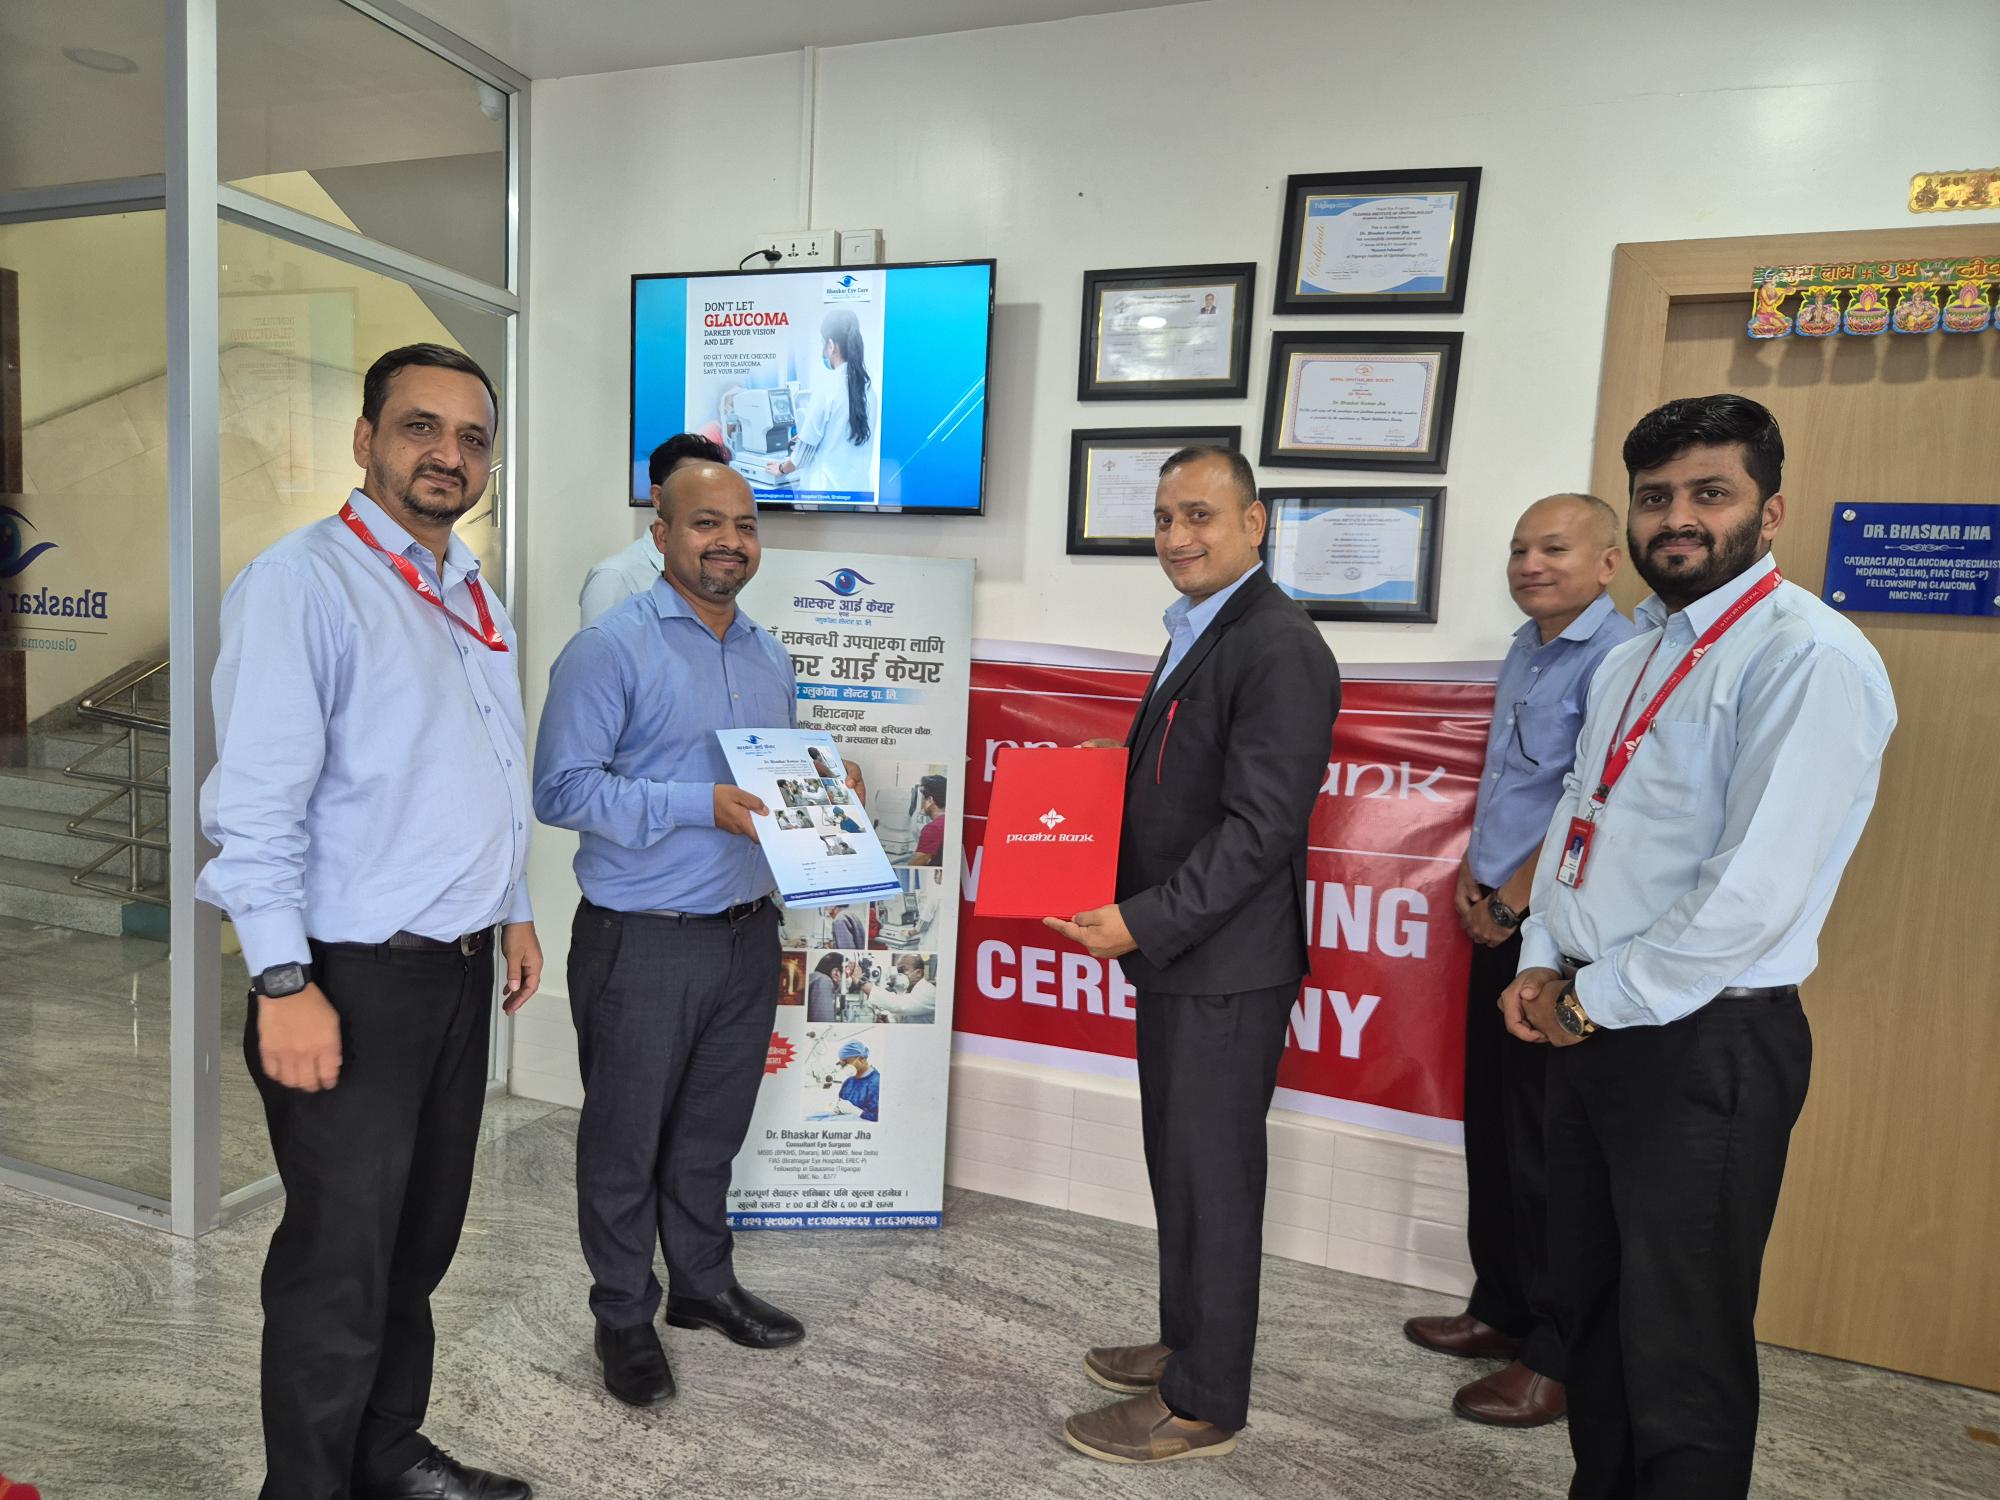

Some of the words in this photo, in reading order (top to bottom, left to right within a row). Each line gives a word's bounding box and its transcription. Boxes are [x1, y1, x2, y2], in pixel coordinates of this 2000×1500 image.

[704, 301, 734, 312] DON'T
[735, 300, 755, 311] LET
[704, 312, 789, 328] GLAUCOMA
[1863, 524, 1888, 539] DR.
[1889, 524, 1961, 540] BHASKAR
[1962, 525, 1992, 541] JHA
[1843, 556, 1886, 567] CATARACT
[1887, 557, 1905, 567] AND
[1906, 558, 1955, 569] GLAUCOMA
[1930, 569, 1950, 578] FIAS
[1865, 579, 1918, 589] FELLOWSHIP
[1918, 580, 1928, 589] IN
[1929, 580, 1976, 590] GLAUCOMA
[1888, 591, 1909, 600] NMC
[793, 596, 836, 610] भास्कर
[839, 597, 864, 613] आई
[866, 599, 895, 614] केयर
[781, 629, 839, 648] सम्बन्धी
[843, 634, 906, 651] उपचारका
[910, 635, 945, 654] लागि
[830, 652, 881, 684] आई
[885, 654, 945, 684] केयर
[812, 704, 866, 720] विराटनगर
[765, 1129, 779, 1140] Dr.
[781, 1129, 819, 1140] Bhaskar
[821, 1129, 853, 1140] Kumar
[854, 1130, 872, 1140] Jha
[817, 1141, 827, 1149] Eye
[828, 1141, 852, 1149] Surgeon
